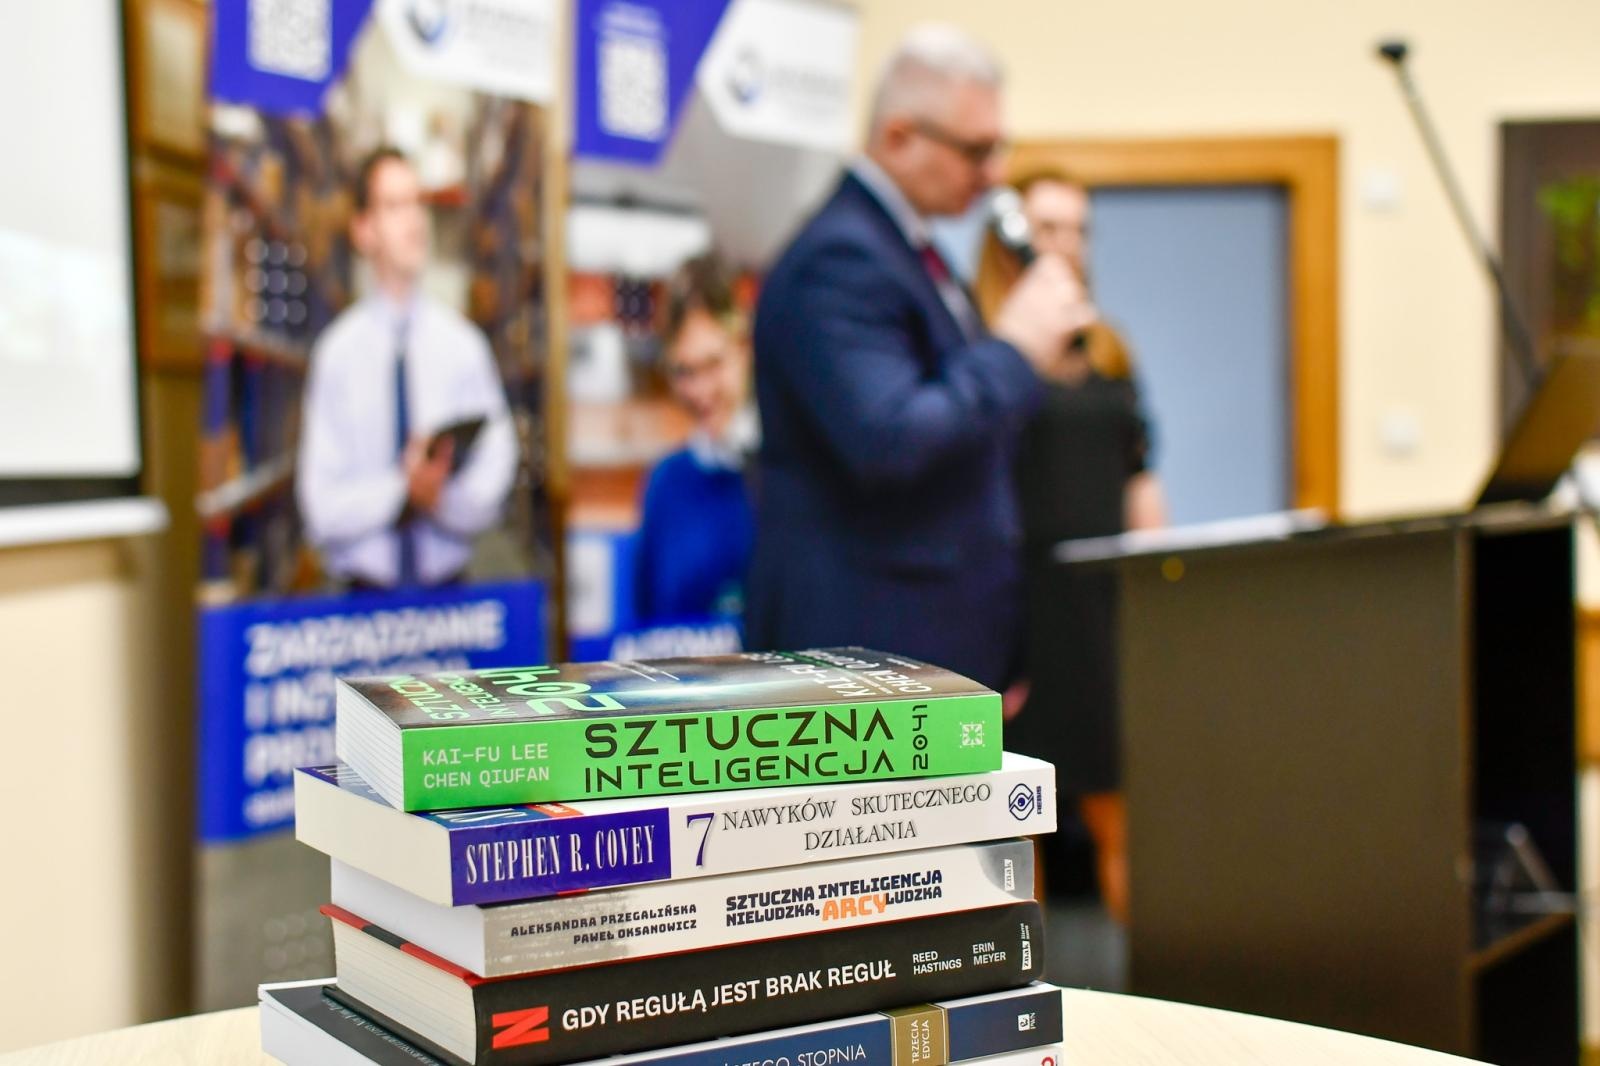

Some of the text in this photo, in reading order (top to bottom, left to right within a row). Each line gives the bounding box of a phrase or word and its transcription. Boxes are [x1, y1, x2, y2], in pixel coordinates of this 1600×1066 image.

[585, 707, 894, 759] SZTUCZNA
[912, 704, 928, 770] 2041
[423, 743, 548, 767] KAI-FU LEE
[424, 766, 549, 789] CHEN QIUFAN
[586, 749, 895, 794] INTELIGENCJA
[686, 784, 991, 867] 7 NAWYKÓW SKUTECZNEGO
[804, 820, 918, 850] DZIAŁANIA
[466, 825, 655, 884] STEPHEN R. COVEY
[726, 870, 943, 911] SZTUCZNA INTELIGENCJA
[511, 904, 697, 937] ALEKSANDRA PRZEGALIŃSKA
[726, 903, 820, 927] NIELUDZKA,
[573, 919, 697, 945] PAWEŁ OKSANOWICZ
[912, 951, 939, 963] REED
[972, 941, 995, 954] ERIN
[973, 951, 1006, 966] MEYER
[913, 958, 962, 975] HASTINGS
[562, 958, 897, 1031] GDY REGUŁĄ JEST BRAK REGUŁ
[922, 1019, 930, 1059] EDYCJA
[798, 1043, 866, 1066] STOPNIA
